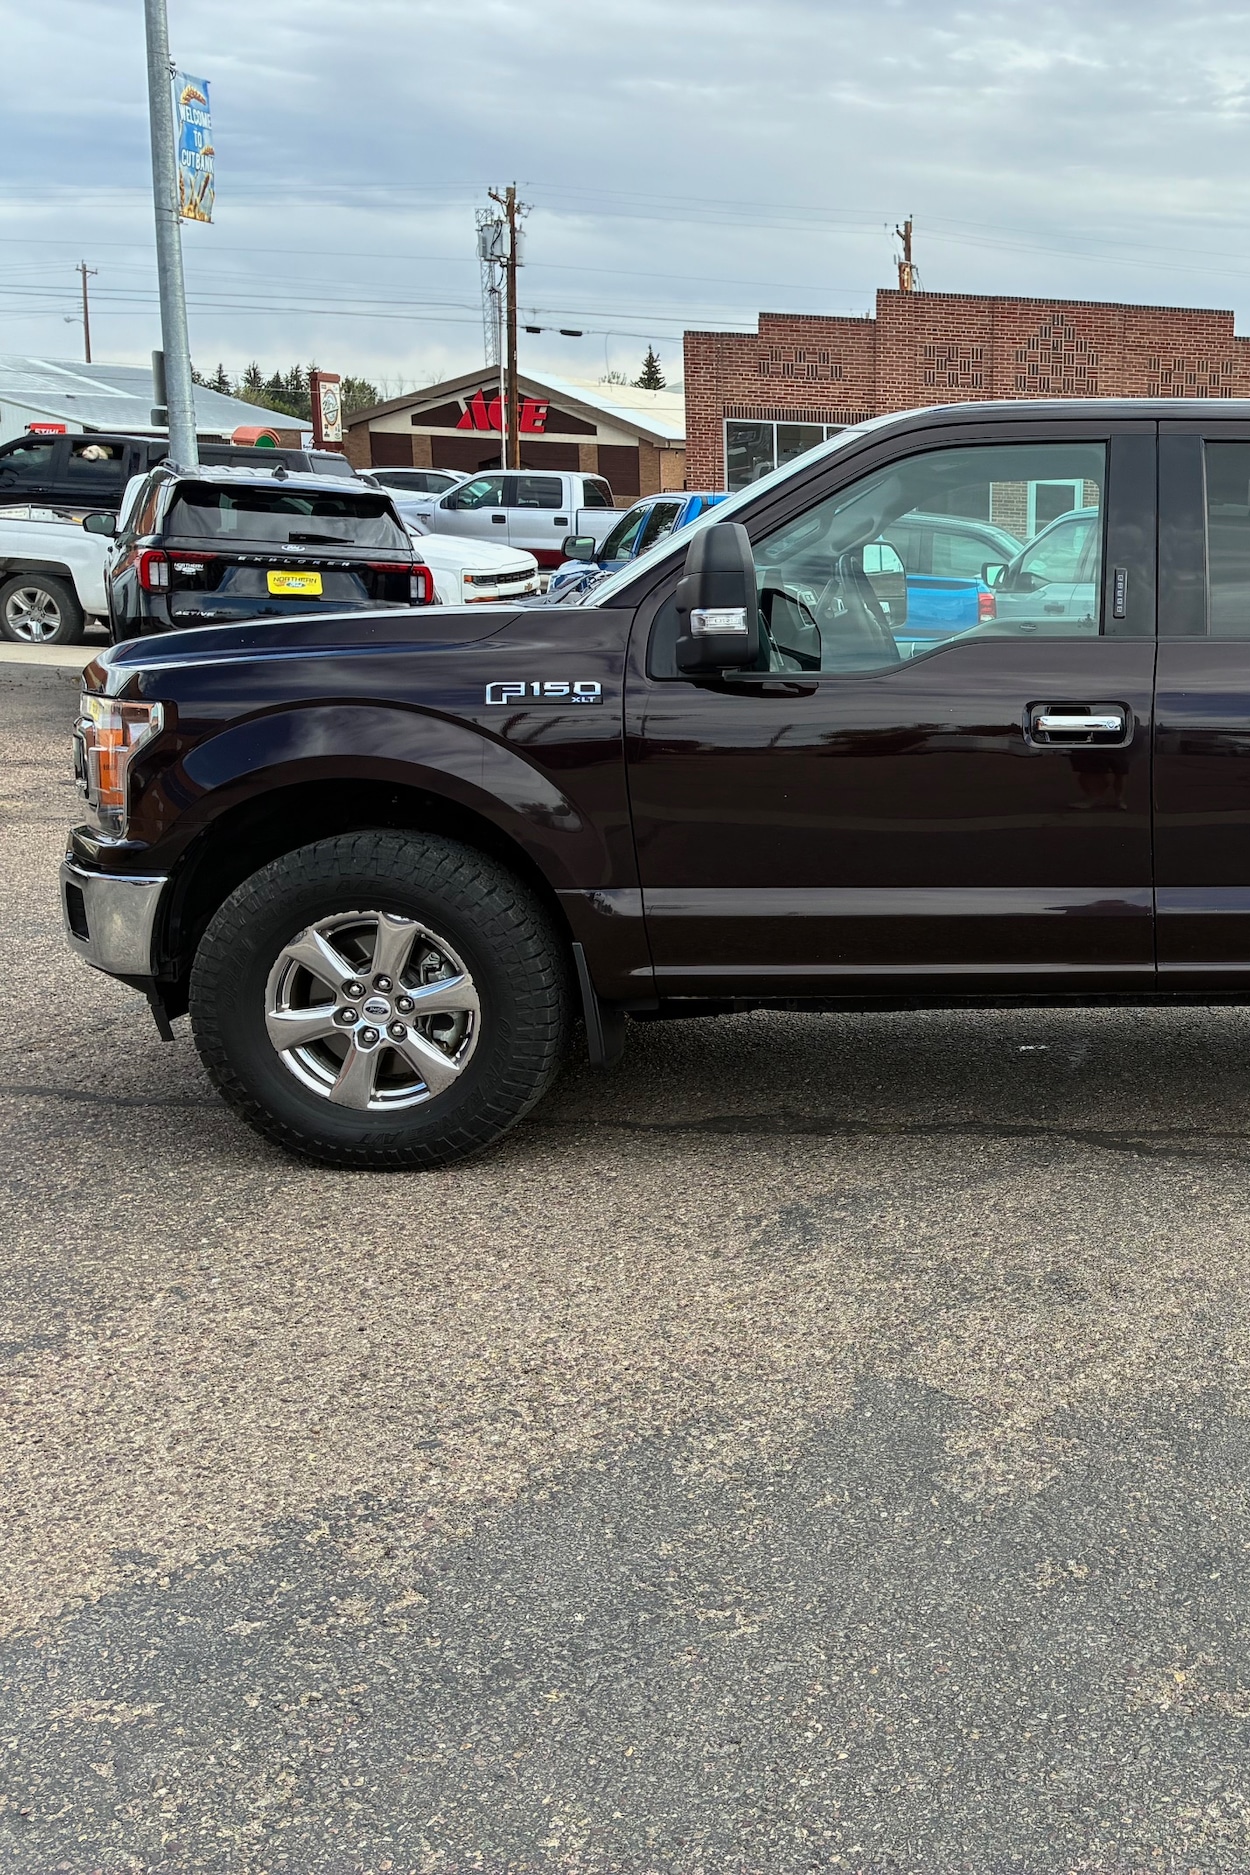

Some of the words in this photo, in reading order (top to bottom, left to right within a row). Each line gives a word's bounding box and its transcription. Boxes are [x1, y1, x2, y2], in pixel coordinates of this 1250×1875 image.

[179, 104, 212, 130] WELCOME
[193, 130, 202, 148] TO
[456, 388, 549, 432] ACE
[238, 555, 350, 567] EXPLORER
[273, 576, 317, 584] NORTHERN
